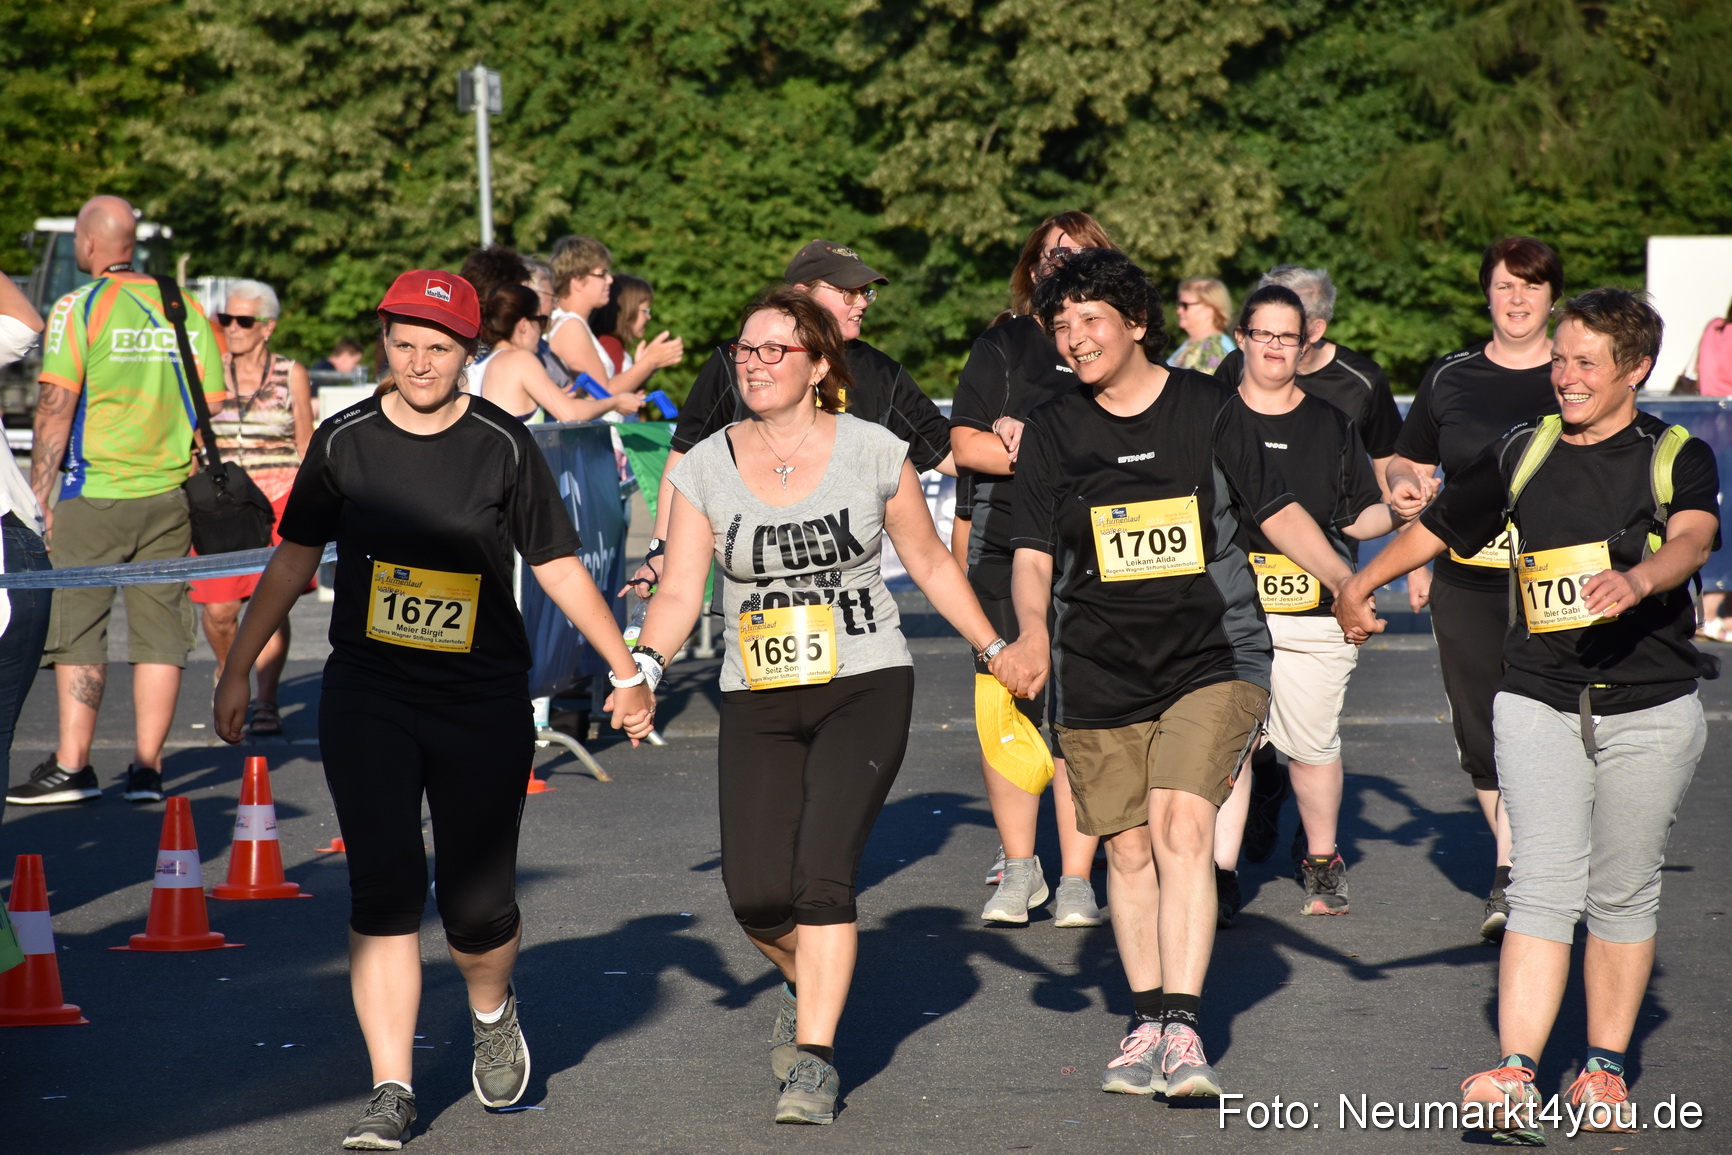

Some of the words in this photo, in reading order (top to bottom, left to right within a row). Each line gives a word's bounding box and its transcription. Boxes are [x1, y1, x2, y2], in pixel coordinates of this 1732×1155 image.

[427, 289, 450, 301] Marlboro
[1454, 351, 1470, 359] JAKO
[342, 408, 361, 420] JAKO
[1510, 421, 1529, 433] JAKO
[1109, 526, 1187, 559] 1709
[1126, 558, 1154, 567] Leikam
[1156, 556, 1176, 564] Alida
[1126, 566, 1145, 574] Wagner
[1146, 563, 1167, 572] Stiftung
[1167, 561, 1199, 569] Lauterhofen
[386, 576, 423, 589] firmenlauf
[1263, 574, 1310, 596] 653
[383, 593, 463, 629] 1672
[1544, 610, 1559, 618] Ibler
[1561, 606, 1581, 616] Gabi
[371, 626, 390, 635] Regens
[391, 630, 411, 640] Wagner
[413, 634, 434, 643] Stiftung
[435, 637, 466, 645] Lauterhofen
[396, 623, 419, 634] Meier
[421, 628, 444, 638] Birgit
[750, 634, 822, 667] 1695
[765, 667, 782, 675] Seitz
